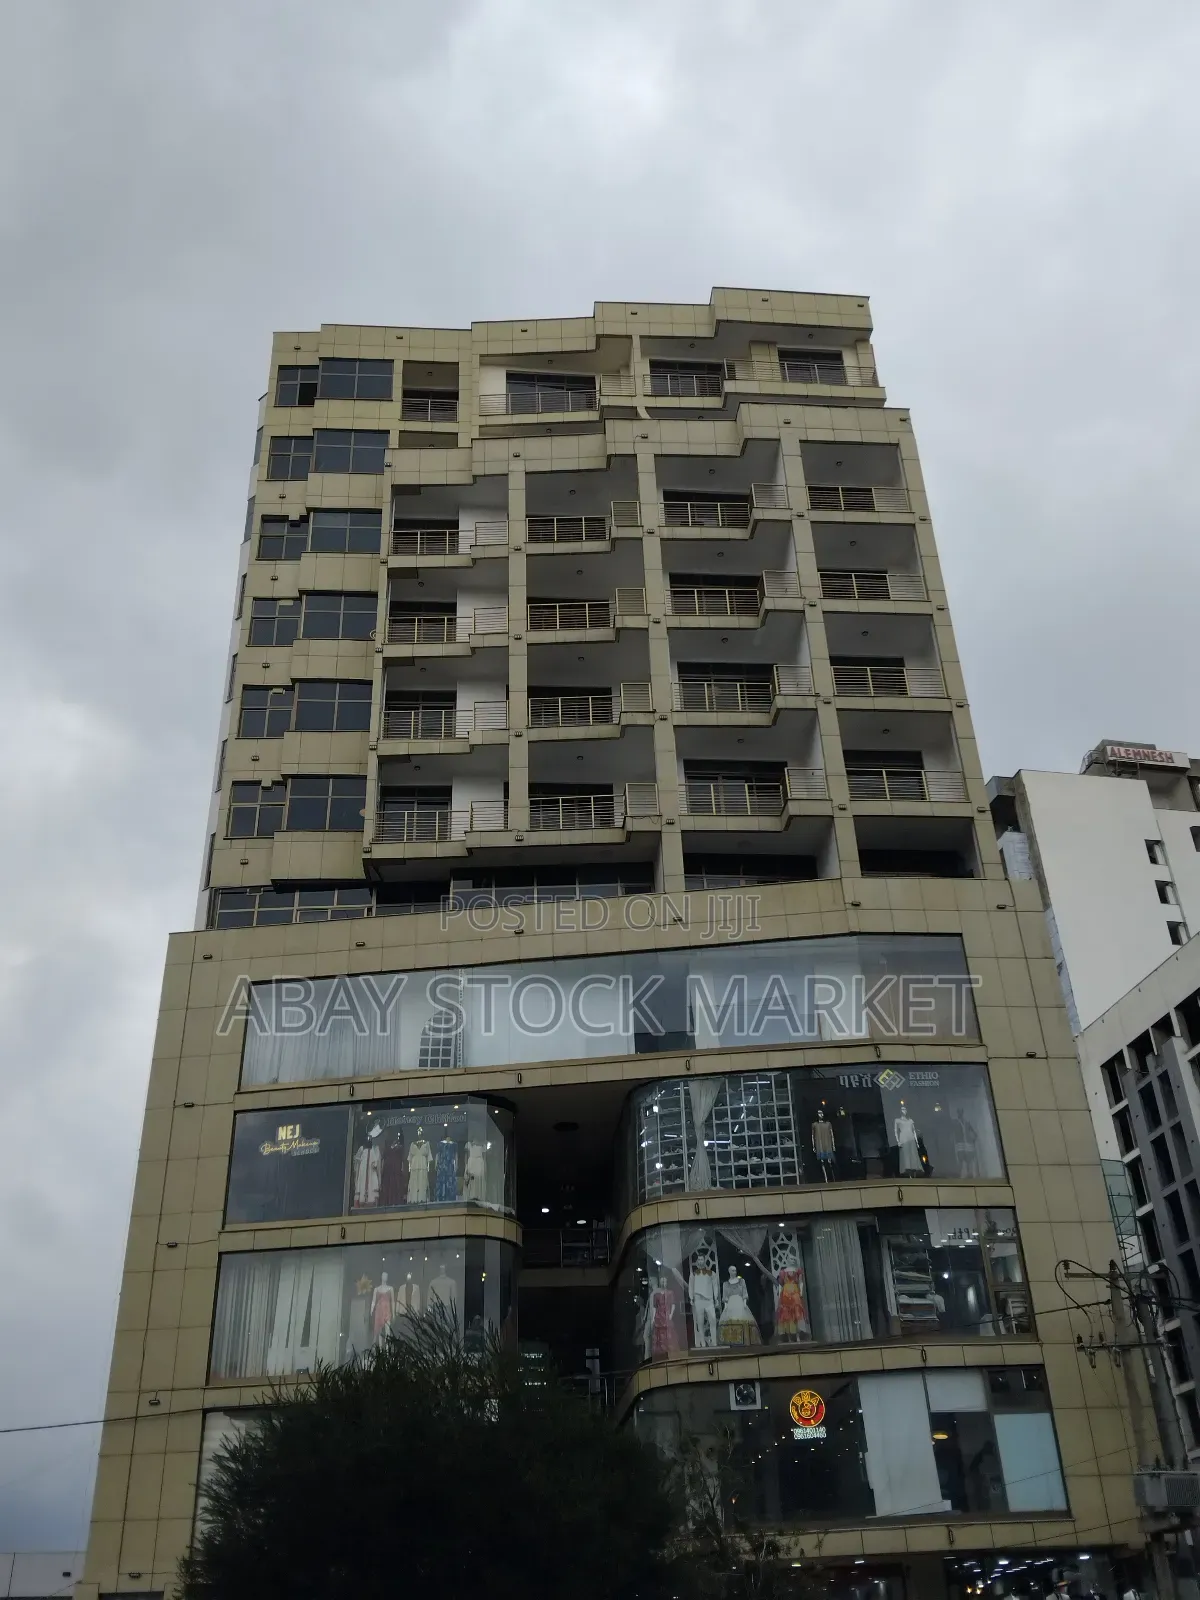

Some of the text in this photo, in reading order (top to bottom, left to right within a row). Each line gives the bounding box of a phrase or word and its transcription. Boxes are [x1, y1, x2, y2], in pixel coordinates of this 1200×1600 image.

[1110, 746, 1174, 763] ALEMNESH
[908, 1071, 939, 1080] ETHIO
[277, 1124, 300, 1141] NEJ
